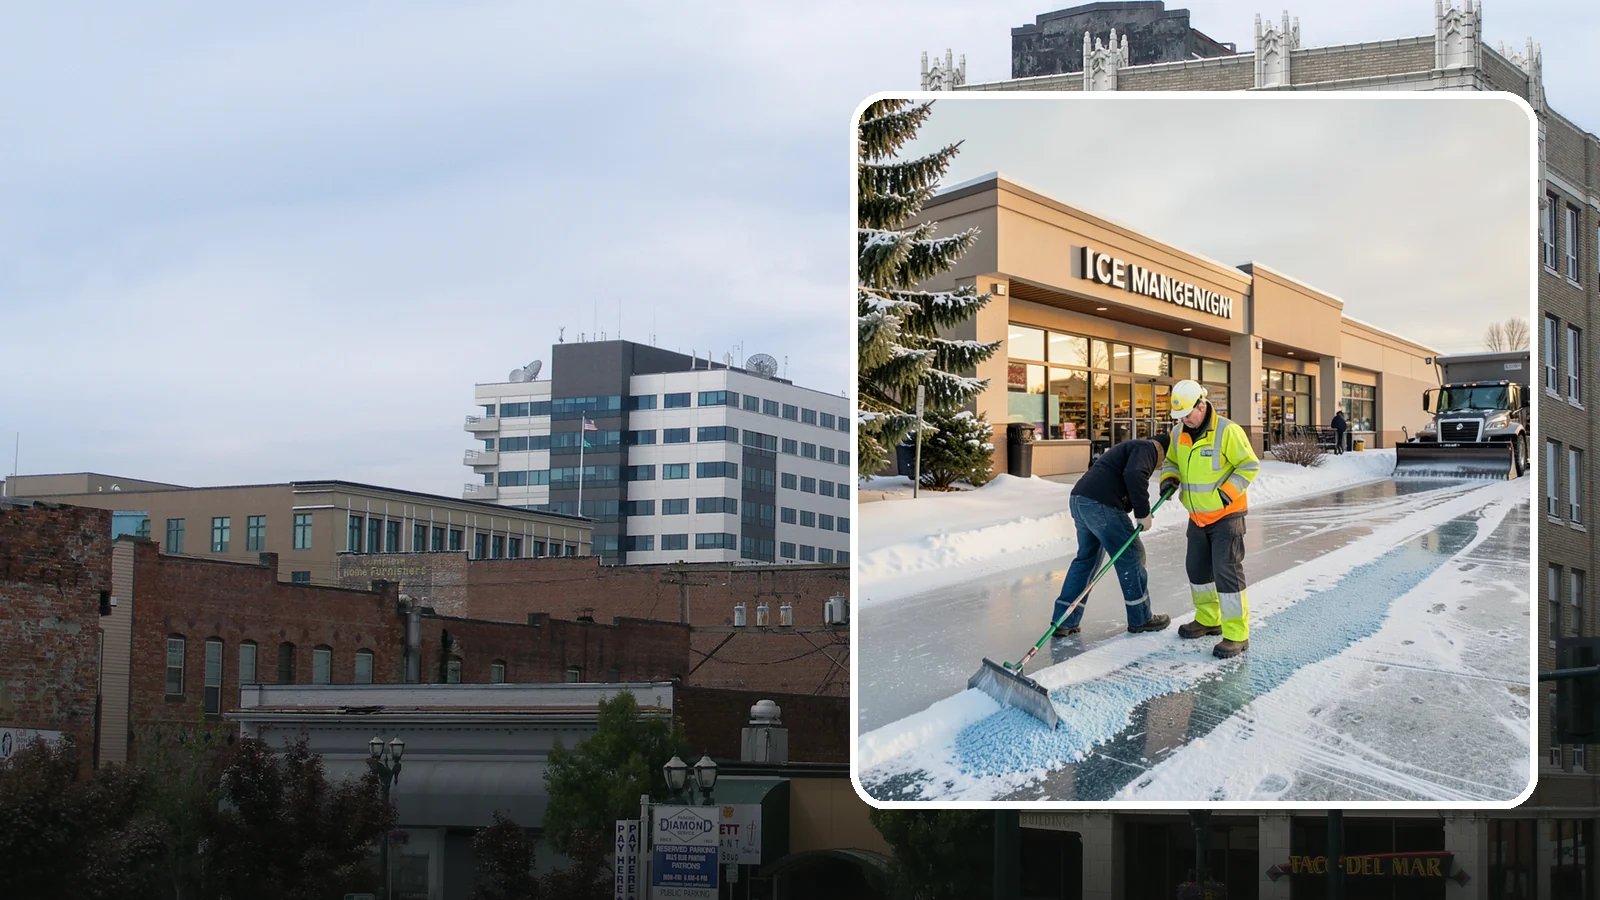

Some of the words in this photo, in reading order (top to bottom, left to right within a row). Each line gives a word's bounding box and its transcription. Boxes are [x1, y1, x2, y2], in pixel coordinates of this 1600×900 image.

[1083, 246, 1126, 289] ICE
[343, 568, 368, 577] Home
[370, 566, 427, 577] Furnishers
[660, 818, 713, 832] DIAMOND
[1022, 815, 1070, 828] BUILDING
[656, 845, 688, 853] RESERVED
[689, 846, 716, 854] PARKING
[671, 862, 701, 870] PATRONS
[1346, 856, 1385, 875] DEL
[1392, 857, 1442, 877] MAR
[660, 889, 682, 897] PUBLIC
[683, 889, 710, 898] PARKING
